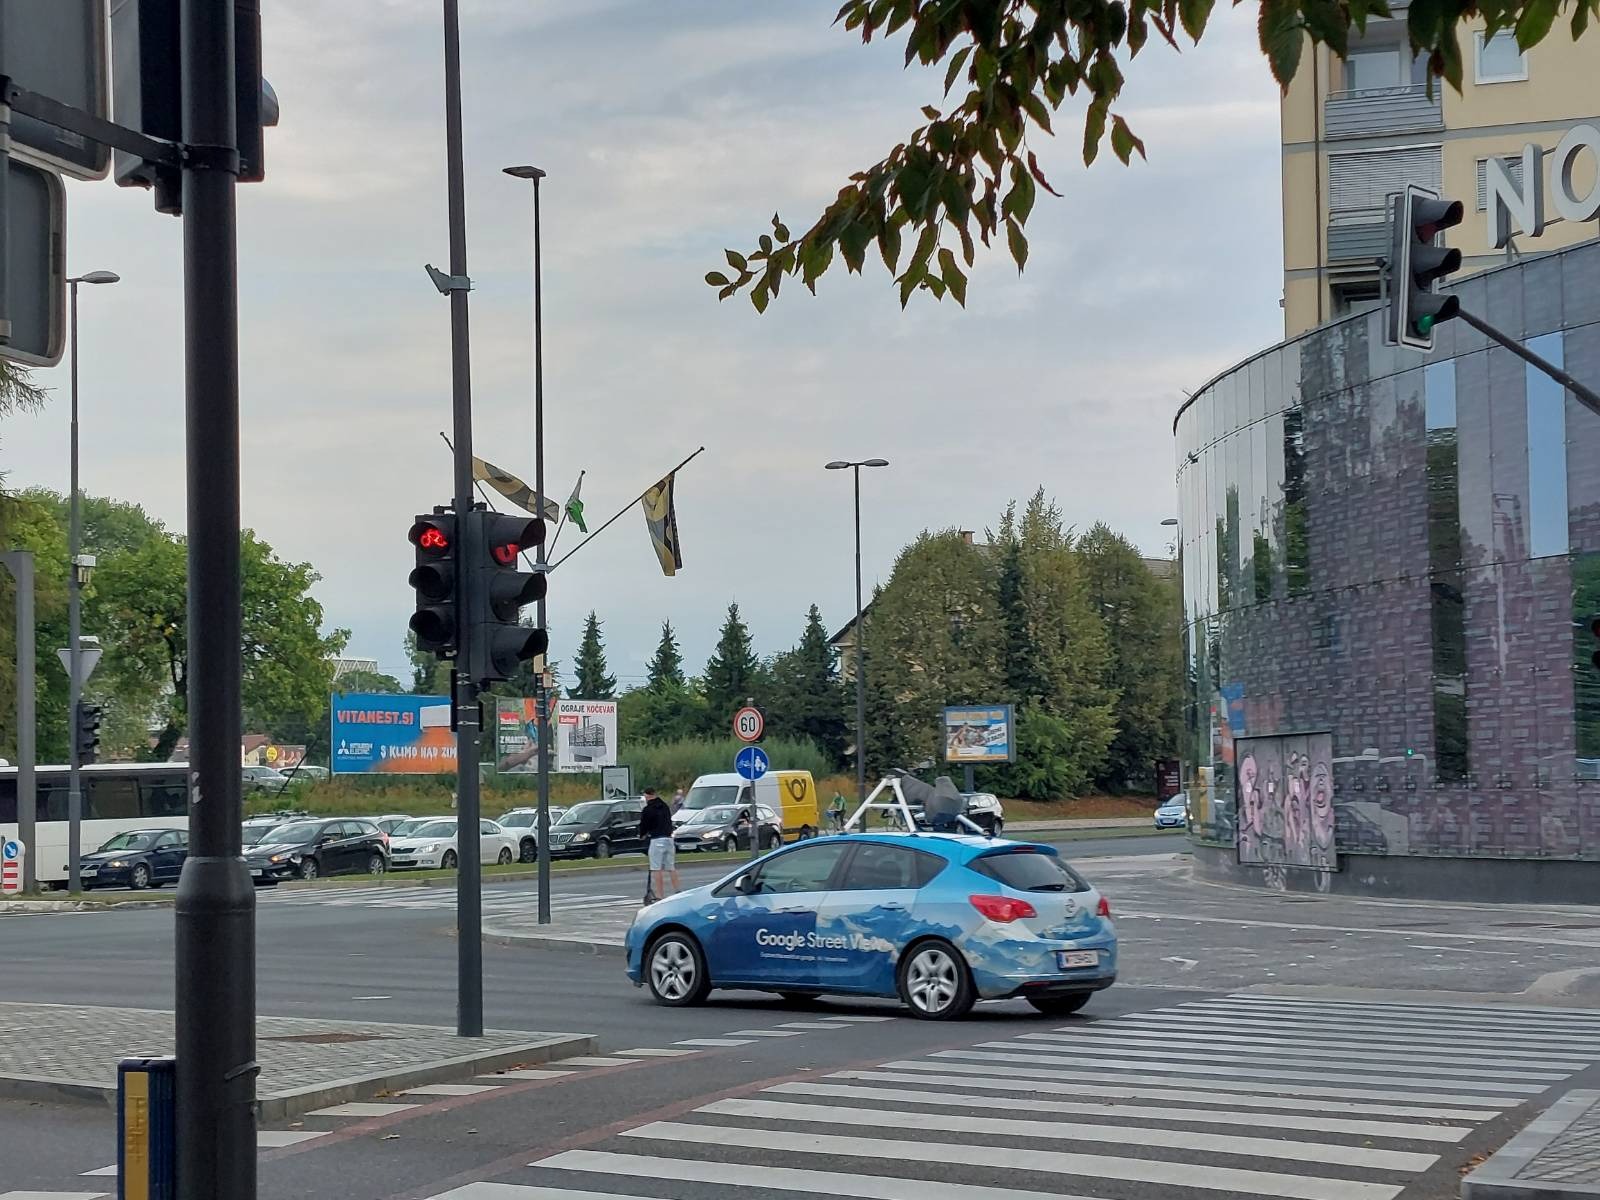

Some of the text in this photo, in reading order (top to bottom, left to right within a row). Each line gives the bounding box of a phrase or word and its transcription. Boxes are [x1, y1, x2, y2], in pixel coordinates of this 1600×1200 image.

[560, 703, 615, 714] OGRAJE KOČEVAR
[337, 710, 414, 725] VITANEST.SI
[741, 717, 756, 732] 60
[380, 744, 387, 759] S
[389, 745, 417, 760] KLIMO
[420, 746, 438, 762] NAD
[441, 746, 457, 760] ZIM
[756, 928, 806, 952] Google
[807, 931, 848, 950] Street
